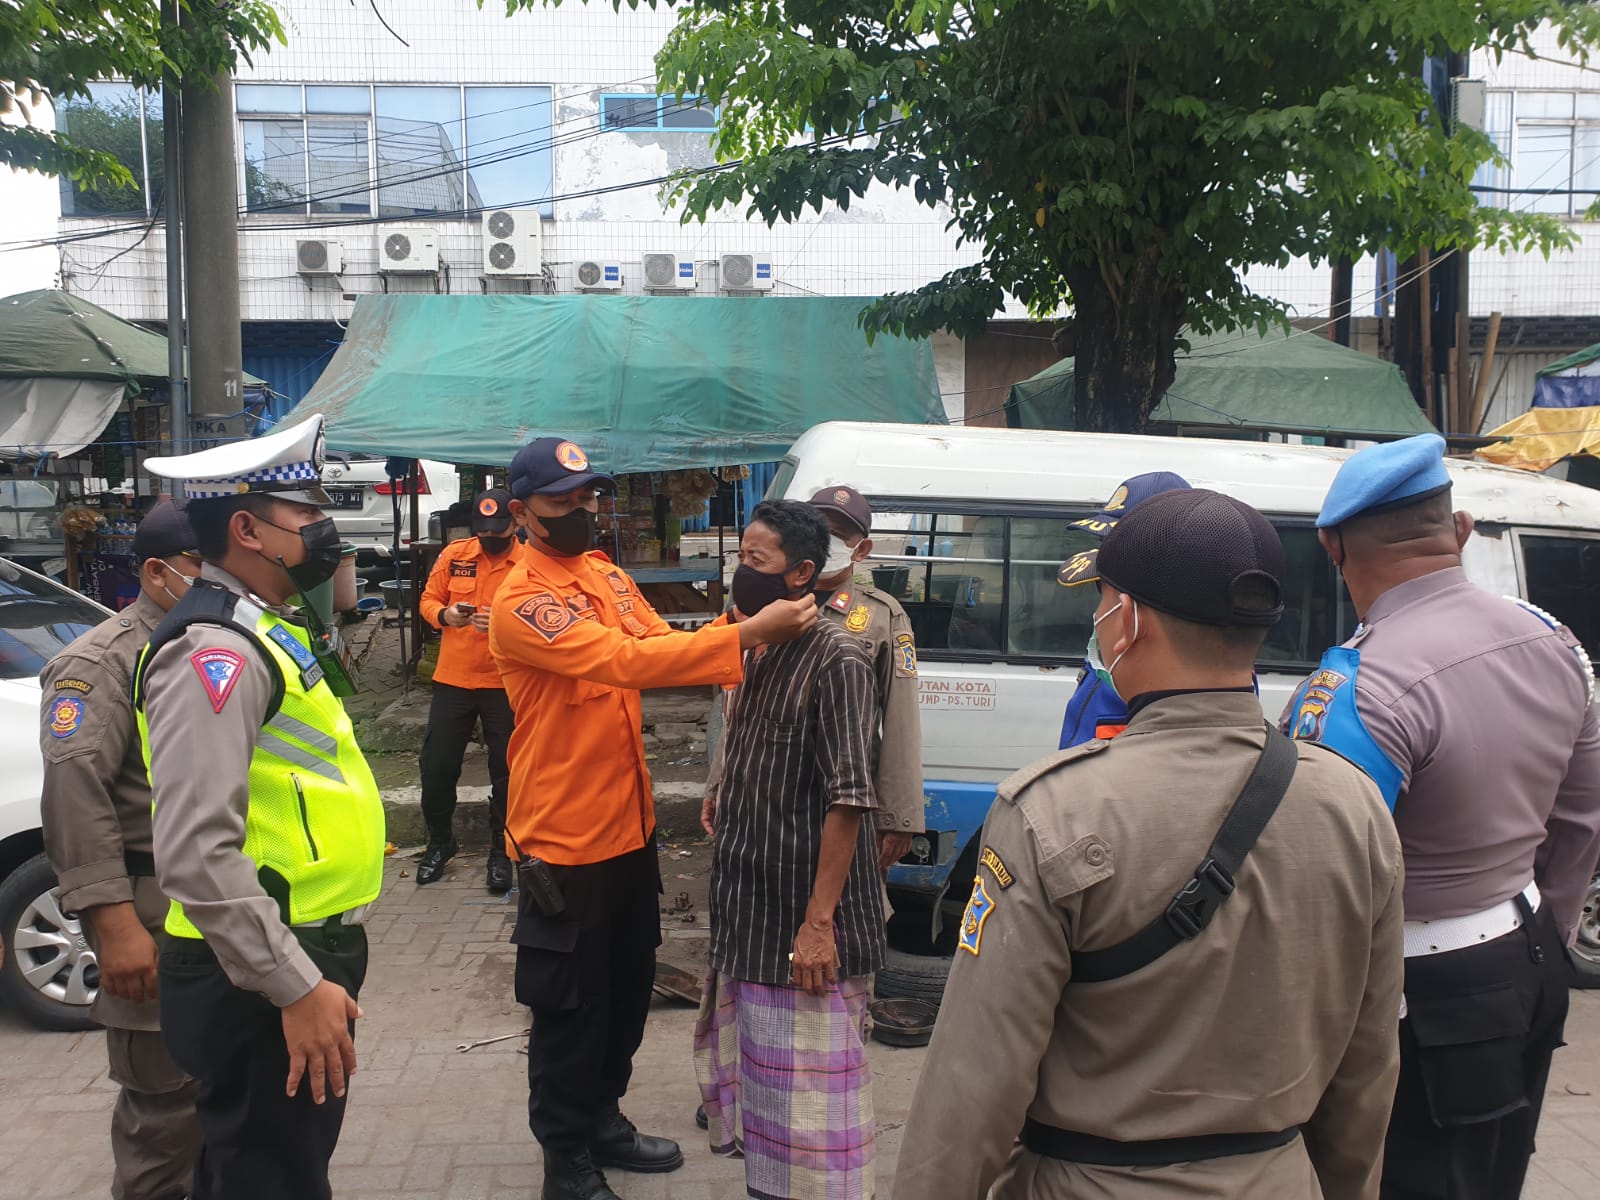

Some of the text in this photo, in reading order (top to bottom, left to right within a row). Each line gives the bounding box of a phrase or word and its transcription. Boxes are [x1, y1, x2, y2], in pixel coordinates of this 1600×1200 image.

[224, 380, 237, 397] 11
[196, 422, 226, 433] PKA
[454, 569, 471, 577] ROI
[956, 682, 991, 693] KOTA
